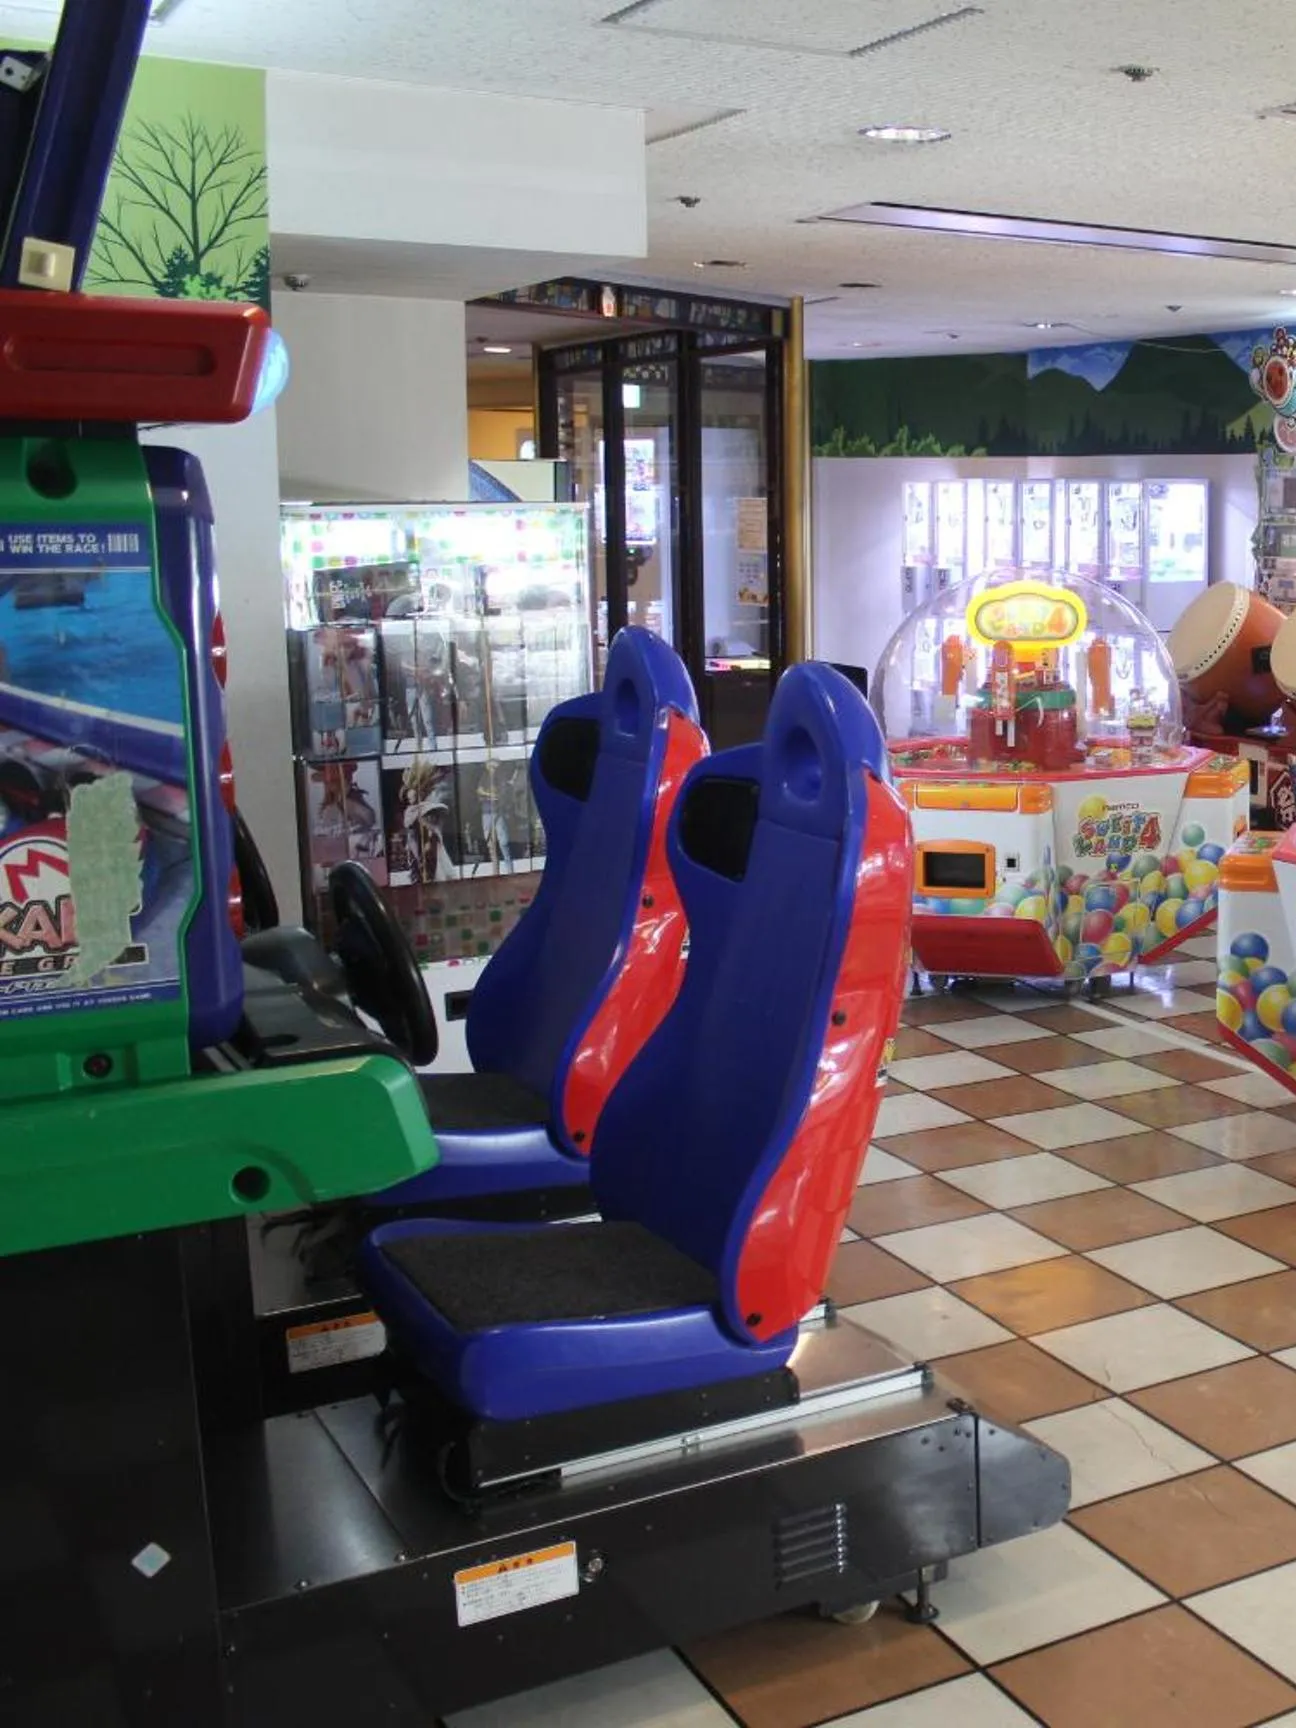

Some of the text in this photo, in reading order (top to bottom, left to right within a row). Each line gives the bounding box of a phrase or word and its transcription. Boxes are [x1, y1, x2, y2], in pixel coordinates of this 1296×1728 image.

[8, 533, 97, 544] USE ITEMS TO
[10, 543, 33, 554] WIN
[38, 543, 61, 554] THE
